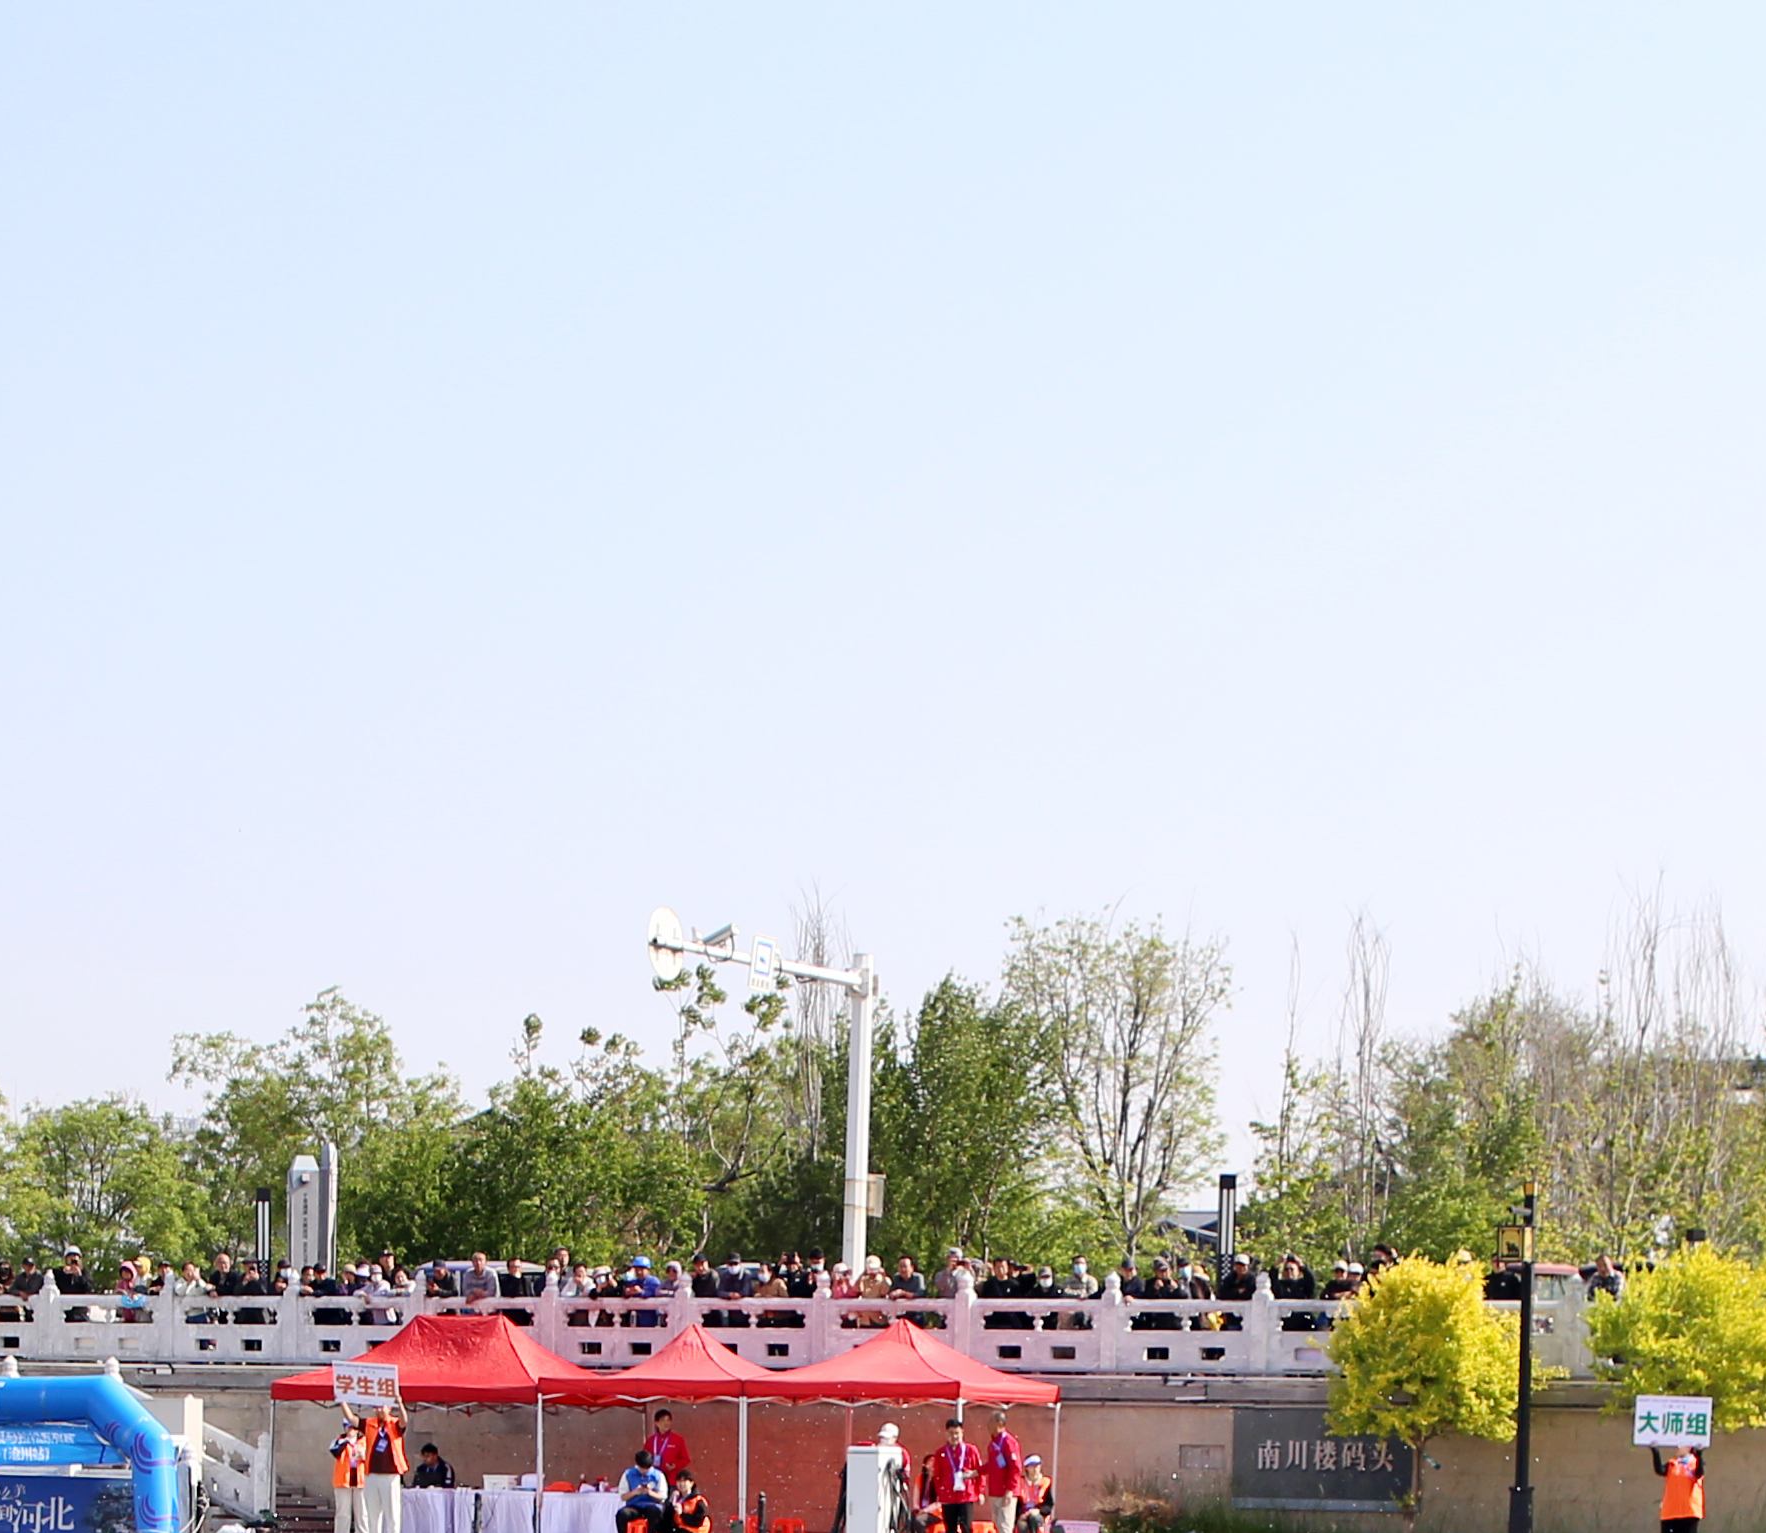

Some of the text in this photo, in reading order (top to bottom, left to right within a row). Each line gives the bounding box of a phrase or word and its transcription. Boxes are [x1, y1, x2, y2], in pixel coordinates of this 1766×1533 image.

[336, 1375, 396, 1398] 学生组
[1638, 1412, 1707, 1436] 大师组
[1256, 1439, 1395, 1473] 南川楼码头
